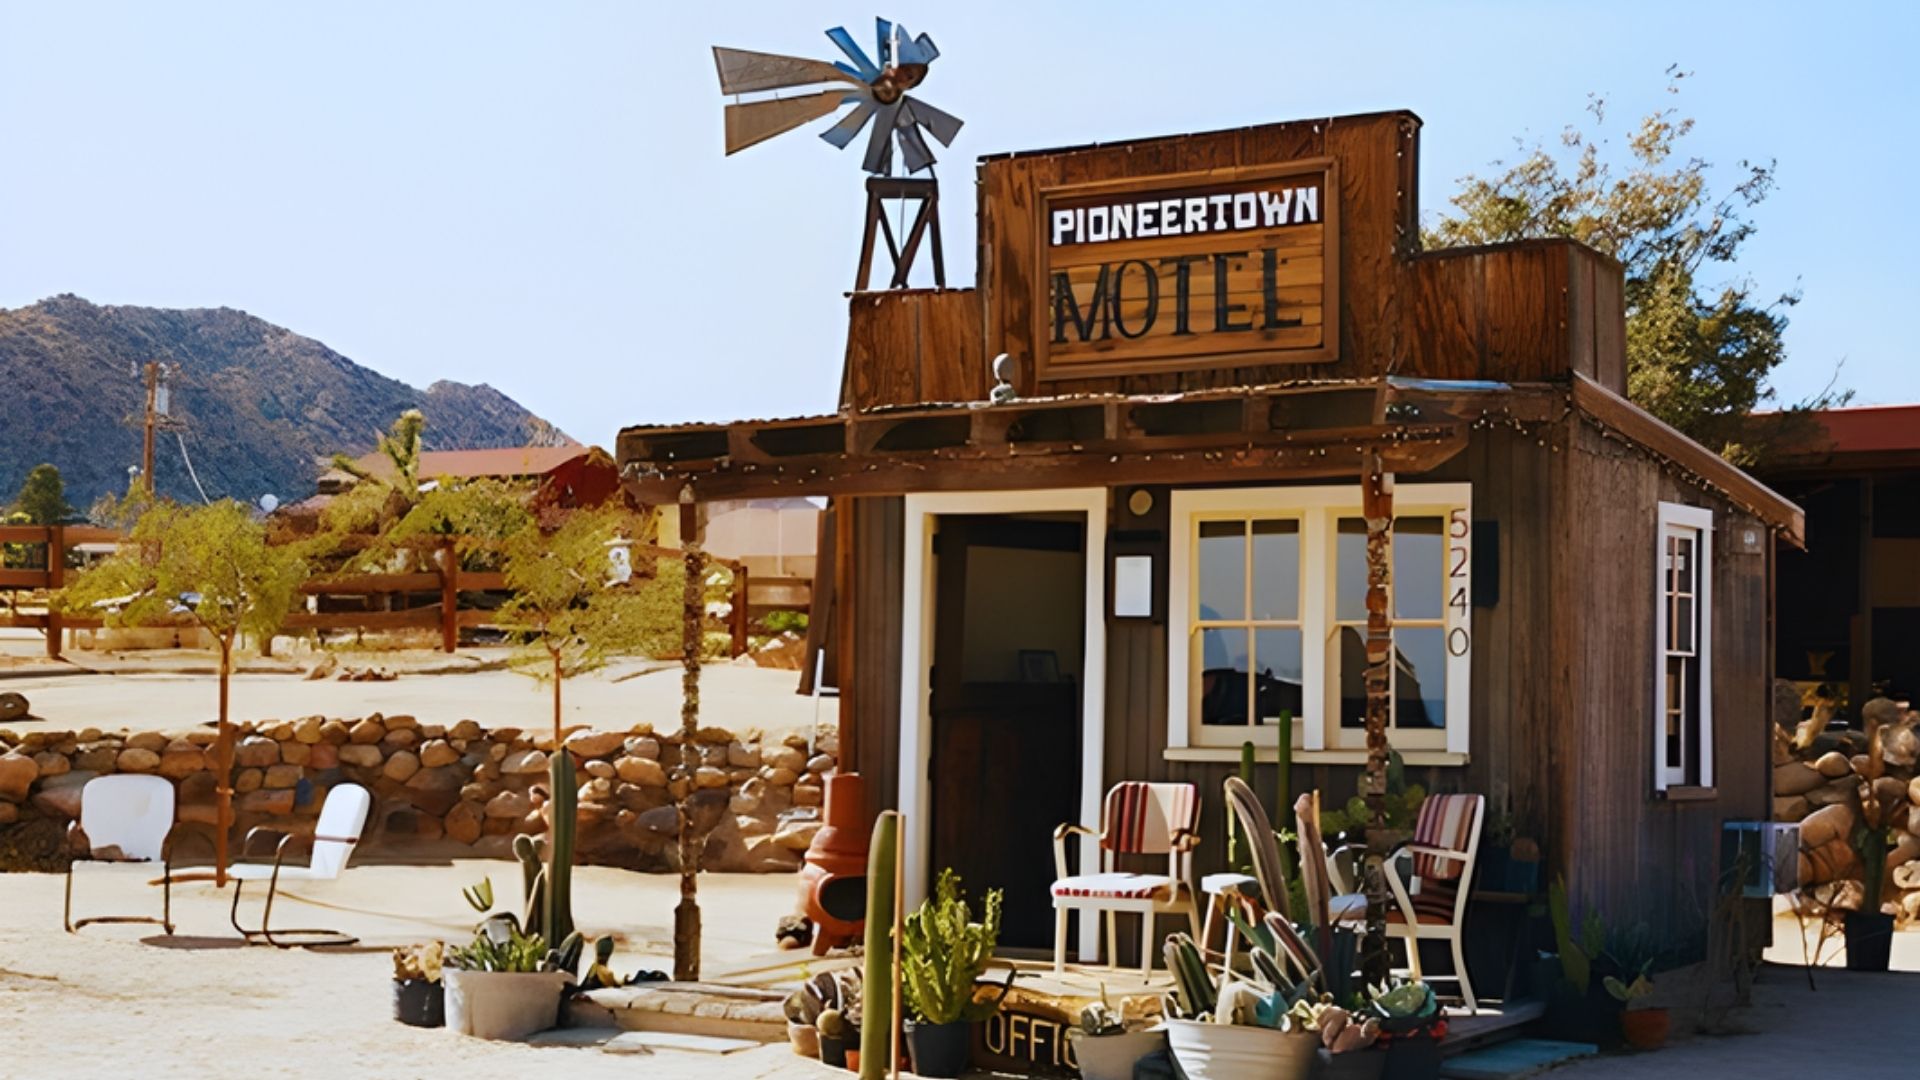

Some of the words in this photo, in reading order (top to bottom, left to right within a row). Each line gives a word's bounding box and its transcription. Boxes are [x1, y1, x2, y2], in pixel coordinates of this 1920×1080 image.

[1052, 187, 1318, 245] PIONEERTOWN
[1051, 248, 1302, 343] MOTEL
[1448, 508, 1469, 657] 5240
[985, 1012, 1079, 1069] OFFIC
